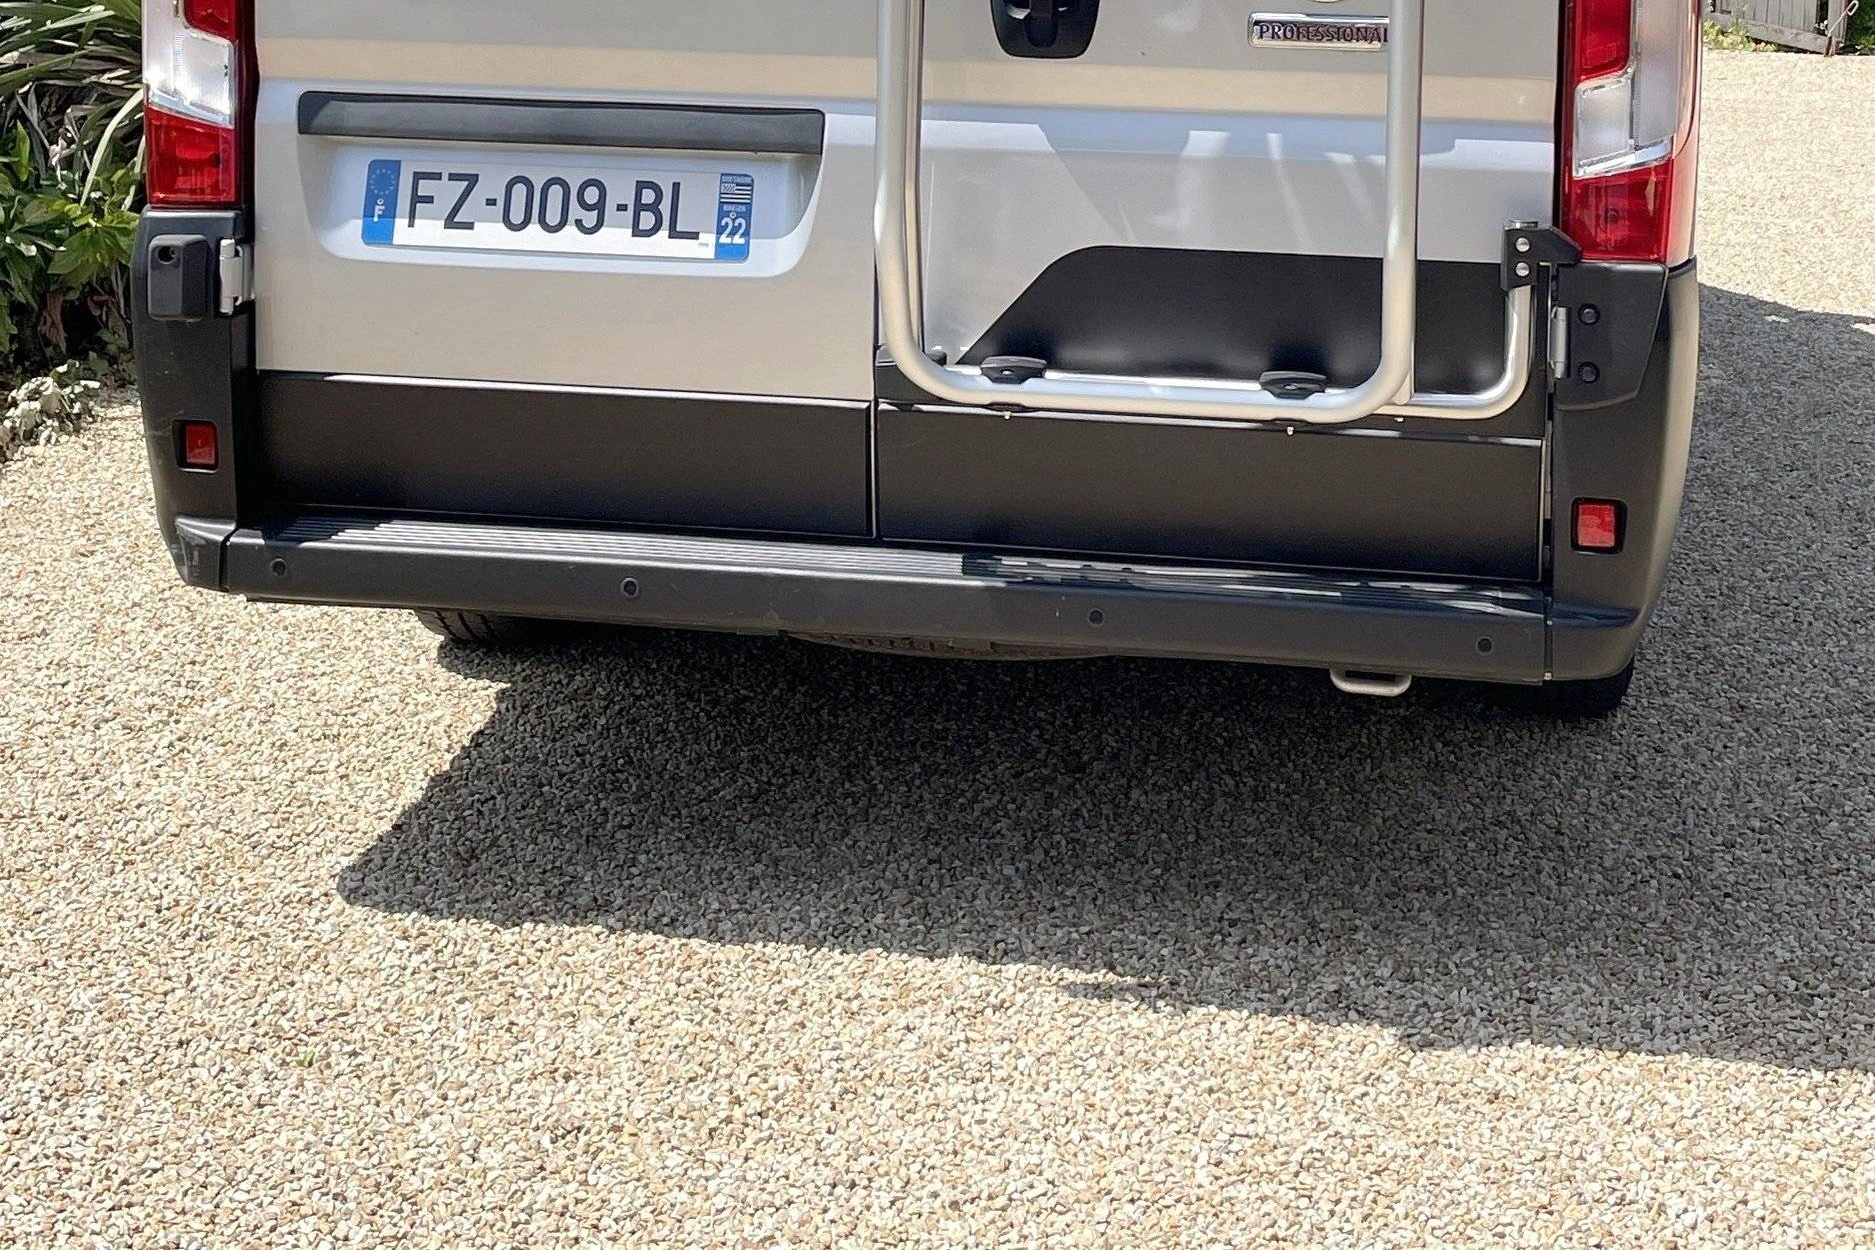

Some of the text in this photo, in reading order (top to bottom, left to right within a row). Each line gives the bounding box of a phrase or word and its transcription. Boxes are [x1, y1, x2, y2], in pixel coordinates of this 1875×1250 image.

[373, 205, 386, 222] F
[407, 170, 701, 240] FZ-009-BL
[718, 217, 747, 245] 22
